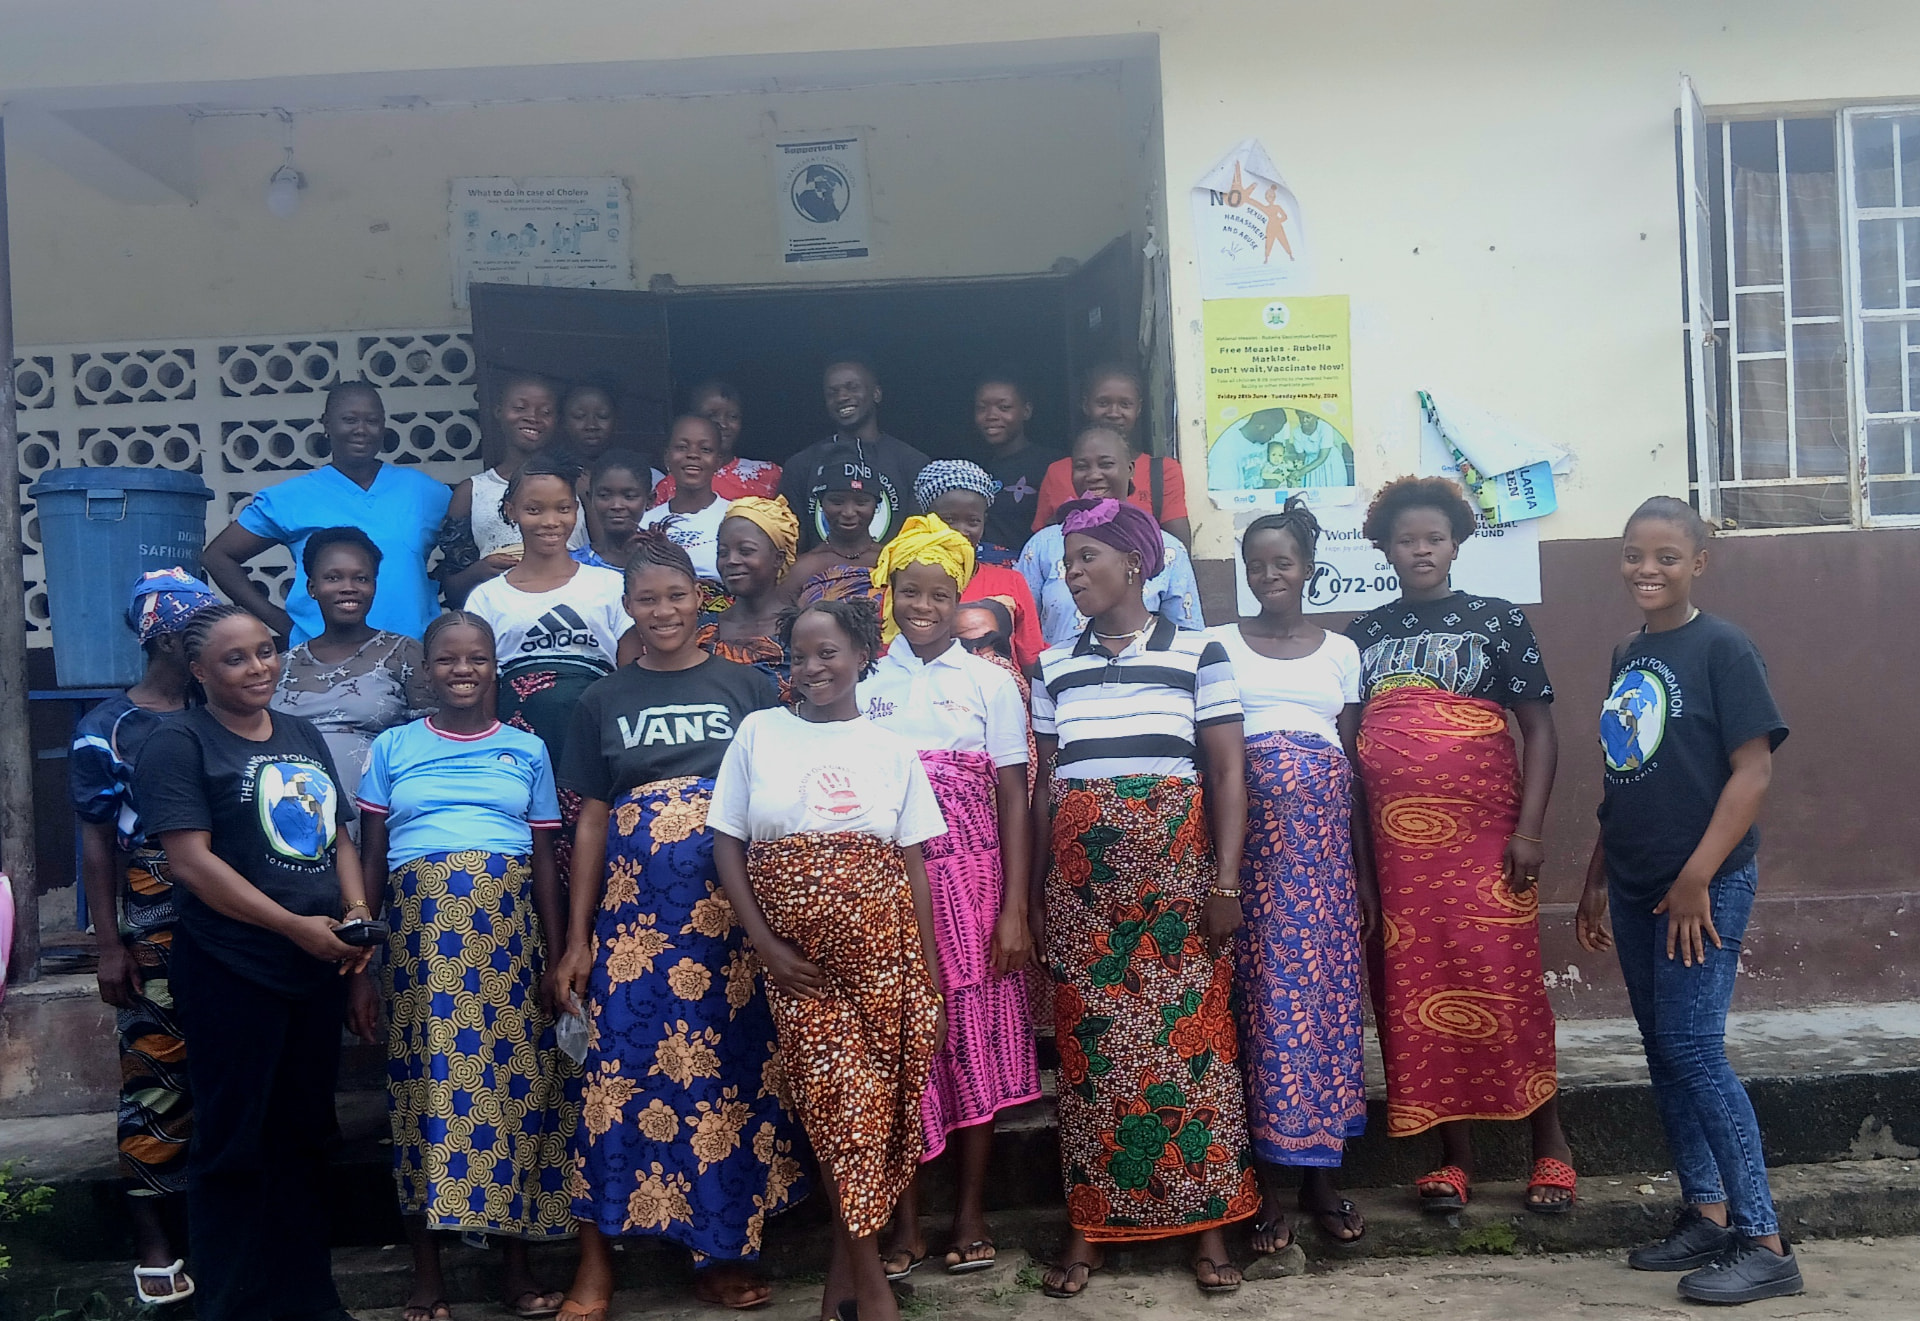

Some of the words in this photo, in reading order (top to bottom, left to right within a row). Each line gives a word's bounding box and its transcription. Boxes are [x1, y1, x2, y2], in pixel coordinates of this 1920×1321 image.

[784, 144, 833, 154] Supported
[468, 189, 490, 197] What
[504, 188, 515, 196] do
[557, 188, 589, 196] Cholera
[1210, 189, 1242, 208] NO
[1246, 207, 1268, 225] SEXUAL
[1224, 213, 1267, 242] HARASSMENT
[1222, 225, 1238, 235] AND
[1238, 231, 1258, 250] ABUSE
[1244, 345, 1284, 353] Measles
[1293, 344, 1332, 352] Rubella
[1252, 355, 1300, 363] Marklate.
[844, 461, 872, 480] DNB
[1520, 466, 1538, 510] LARIA
[1474, 530, 1504, 538] FUND
[1374, 562, 1391, 571] Call
[1330, 576, 1402, 594] 072-00
[520, 629, 600, 653] adidas
[1648, 657, 1683, 718] FOUNDATION
[616, 703, 734, 750] VANS
[240, 780, 254, 804] THE
